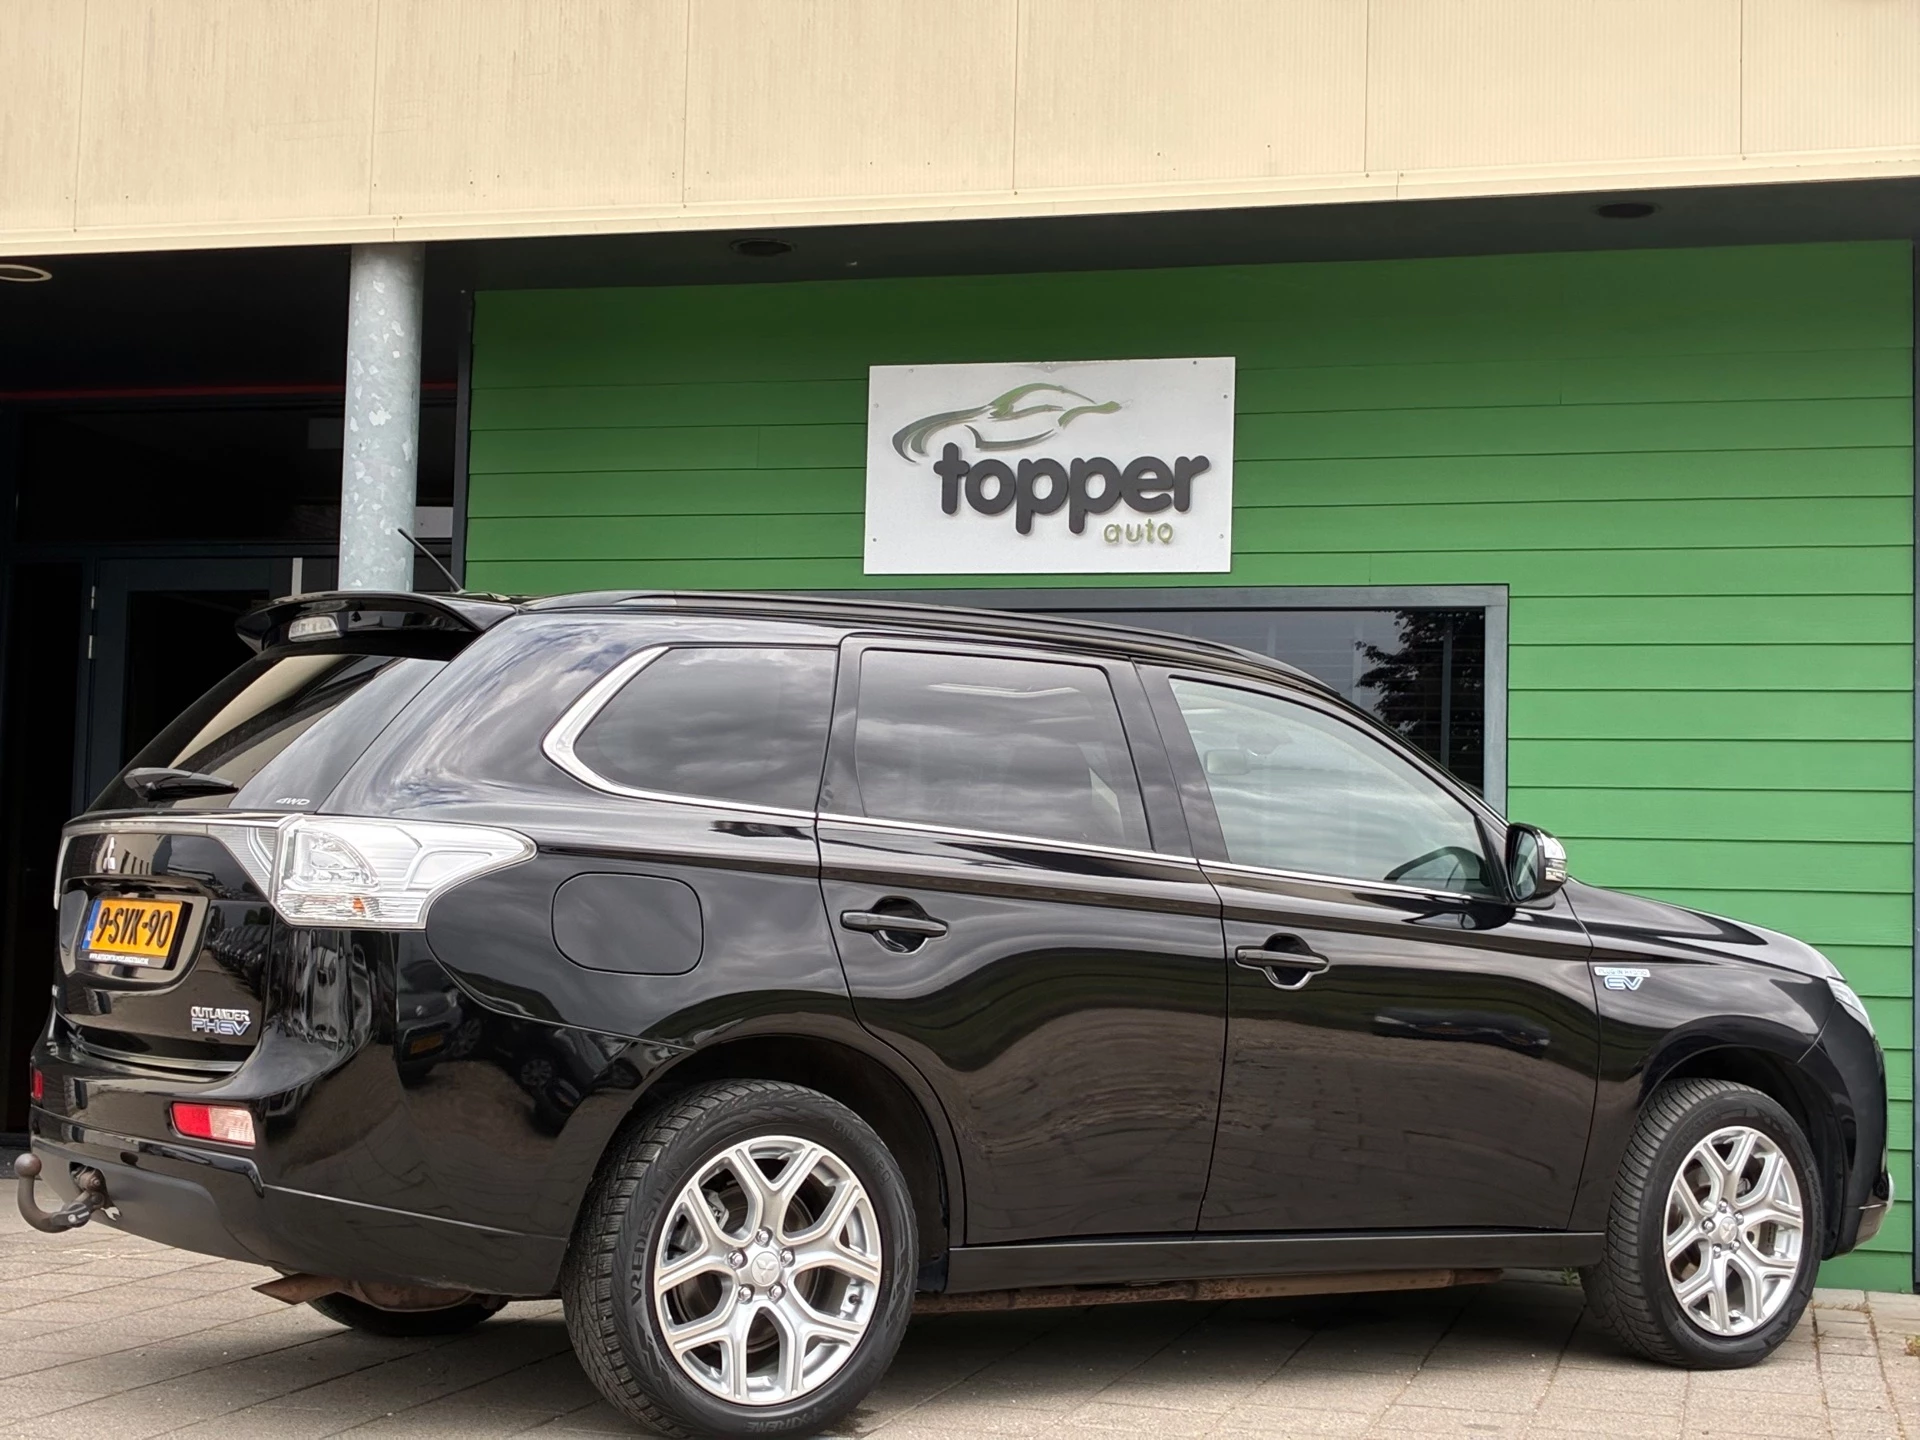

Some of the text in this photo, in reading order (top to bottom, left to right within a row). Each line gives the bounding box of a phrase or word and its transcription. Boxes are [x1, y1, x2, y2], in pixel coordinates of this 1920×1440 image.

[933, 442, 1209, 534] topper
[1103, 519, 1174, 545] auto
[275, 797, 311, 806] 4WD
[96, 907, 173, 949] 9-SVK-90
[1604, 976, 1644, 991] EV
[191, 1006, 250, 1021] OUTLANDER
[191, 1017, 251, 1036] PHEV
